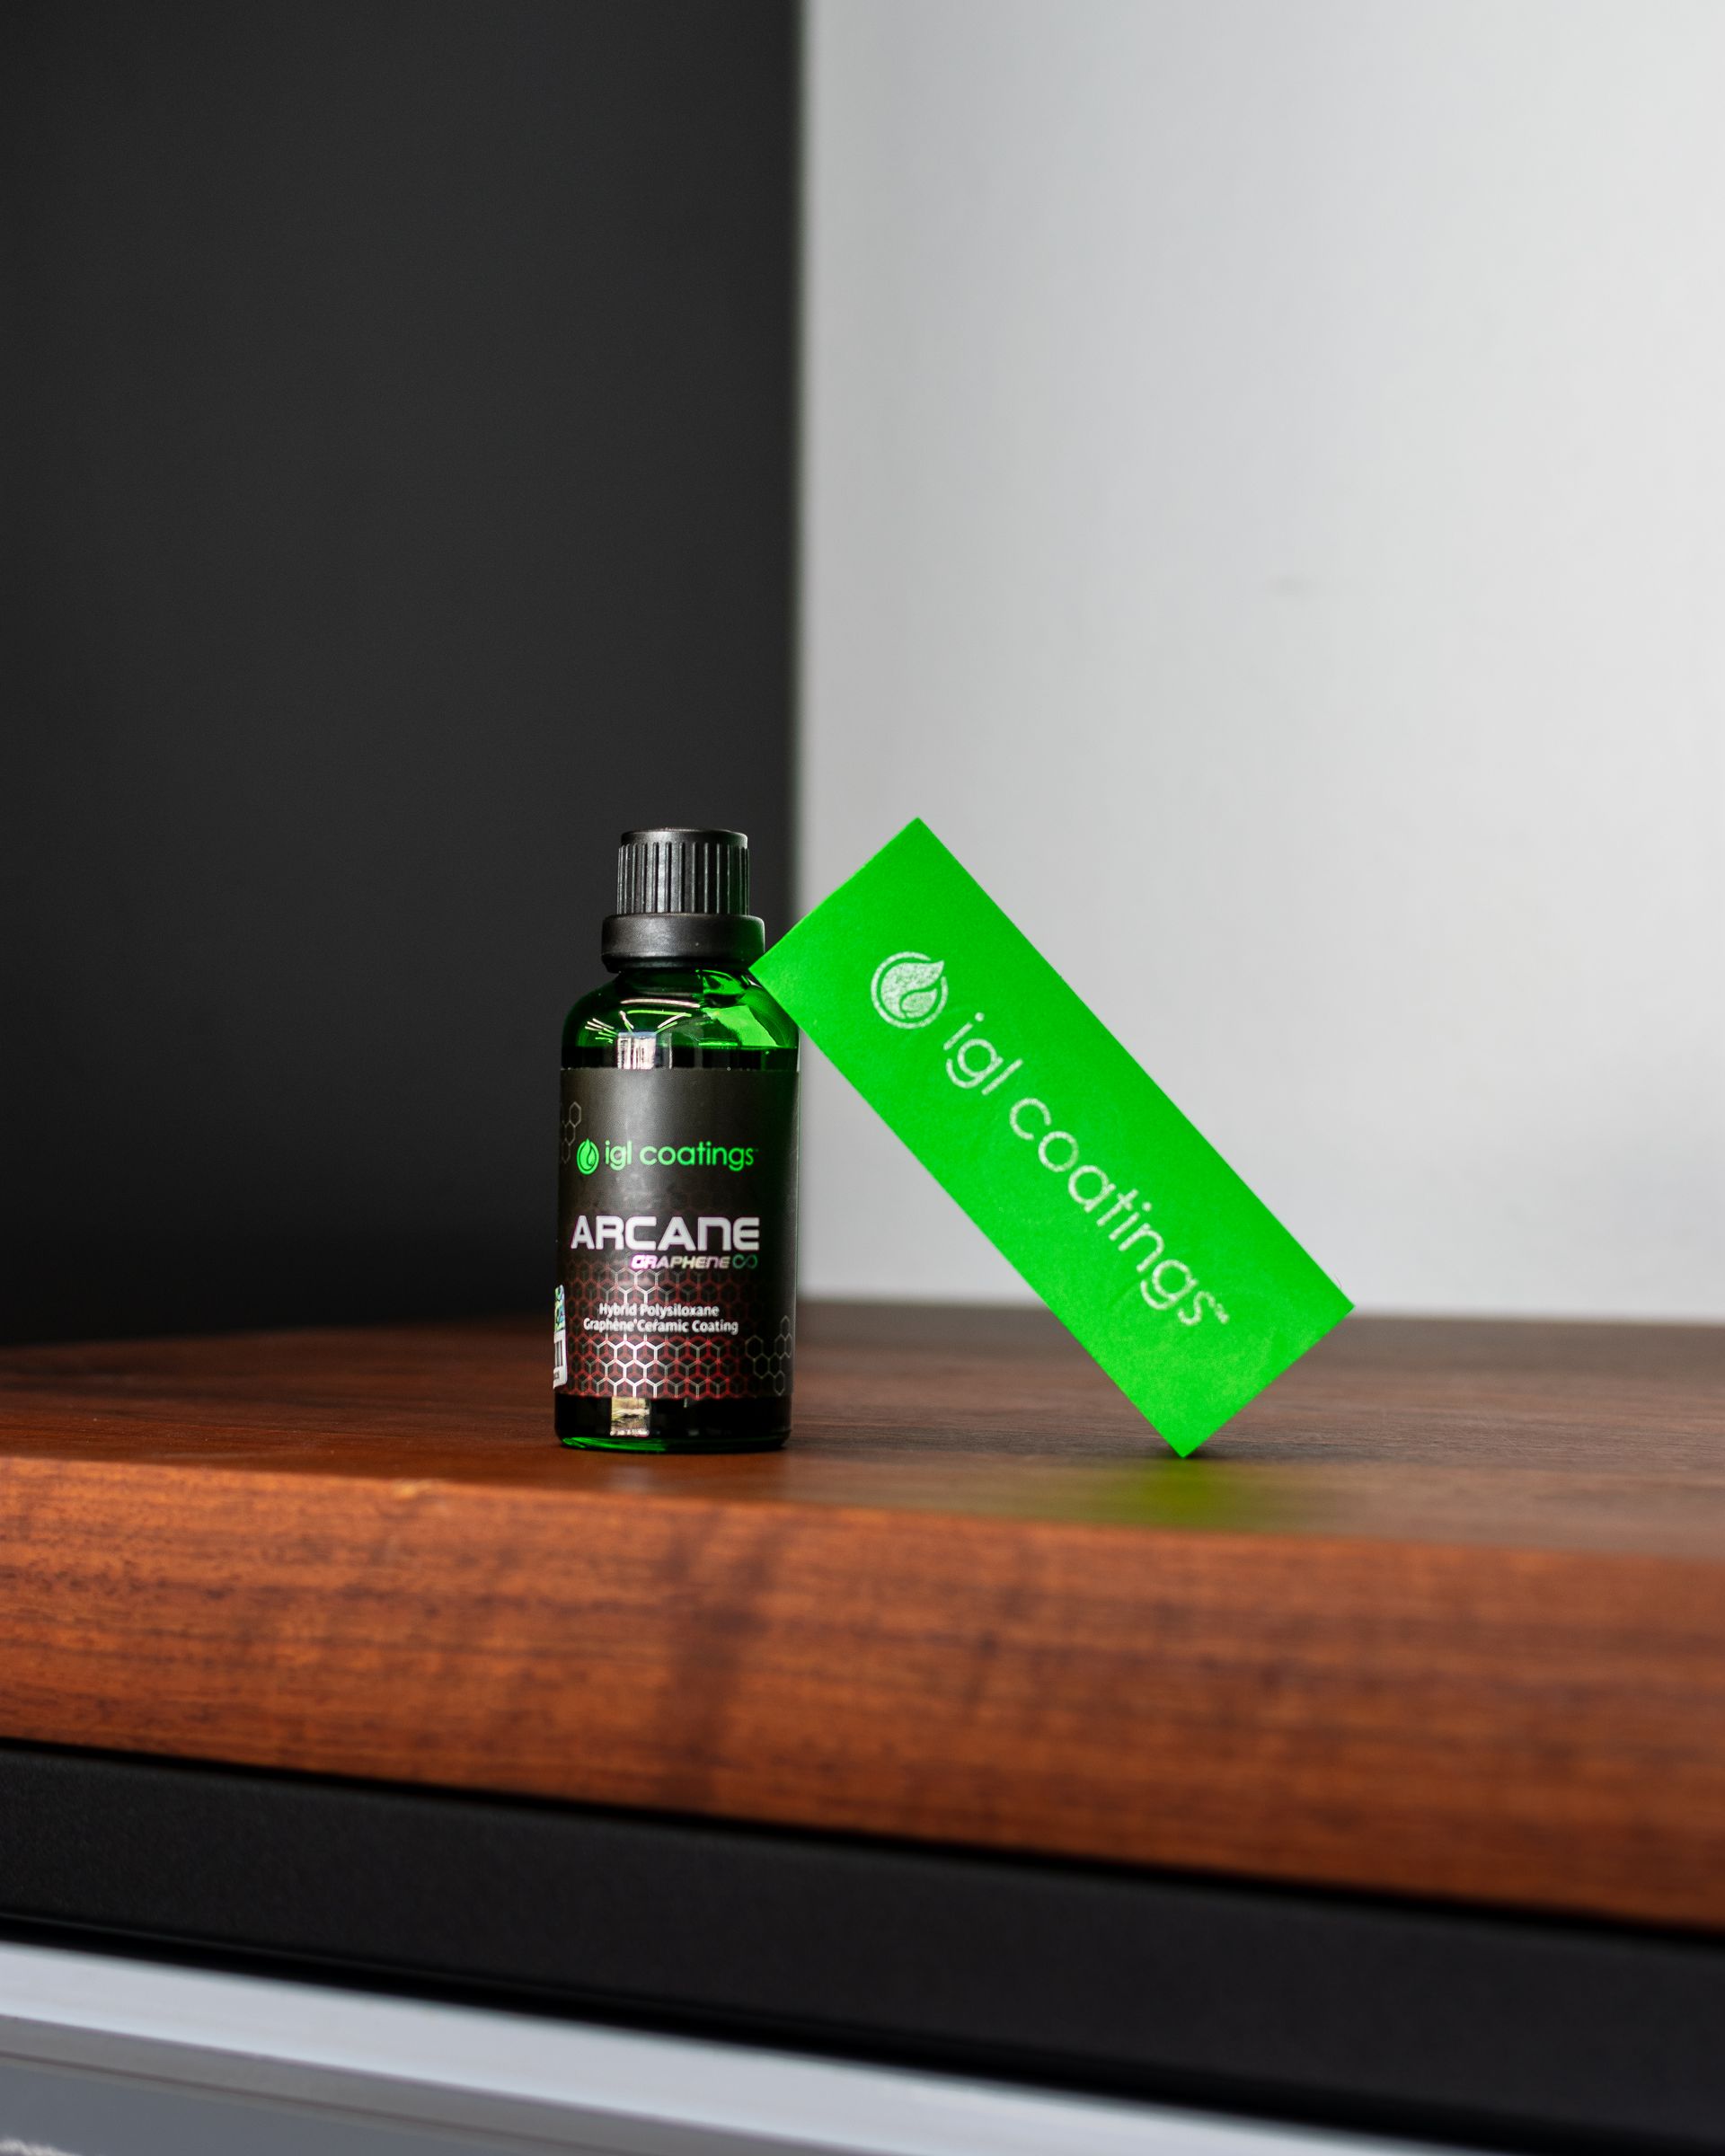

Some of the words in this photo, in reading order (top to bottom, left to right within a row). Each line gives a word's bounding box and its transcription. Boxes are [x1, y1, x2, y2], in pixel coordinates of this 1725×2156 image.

[943, 1012, 1023, 1095] igl
[605, 1140, 632, 1171] igl
[639, 1141, 755, 1171] coatings
[571, 1215, 760, 1251] ARCANE
[631, 1254, 730, 1269] GRAPHENE
[598, 1303, 637, 1318] Hybrid
[640, 1303, 720, 1319] Polysiloxane
[583, 1318, 634, 1333] Graphene
[636, 1319, 689, 1333] Ceramic
[691, 1319, 739, 1336] Coating
